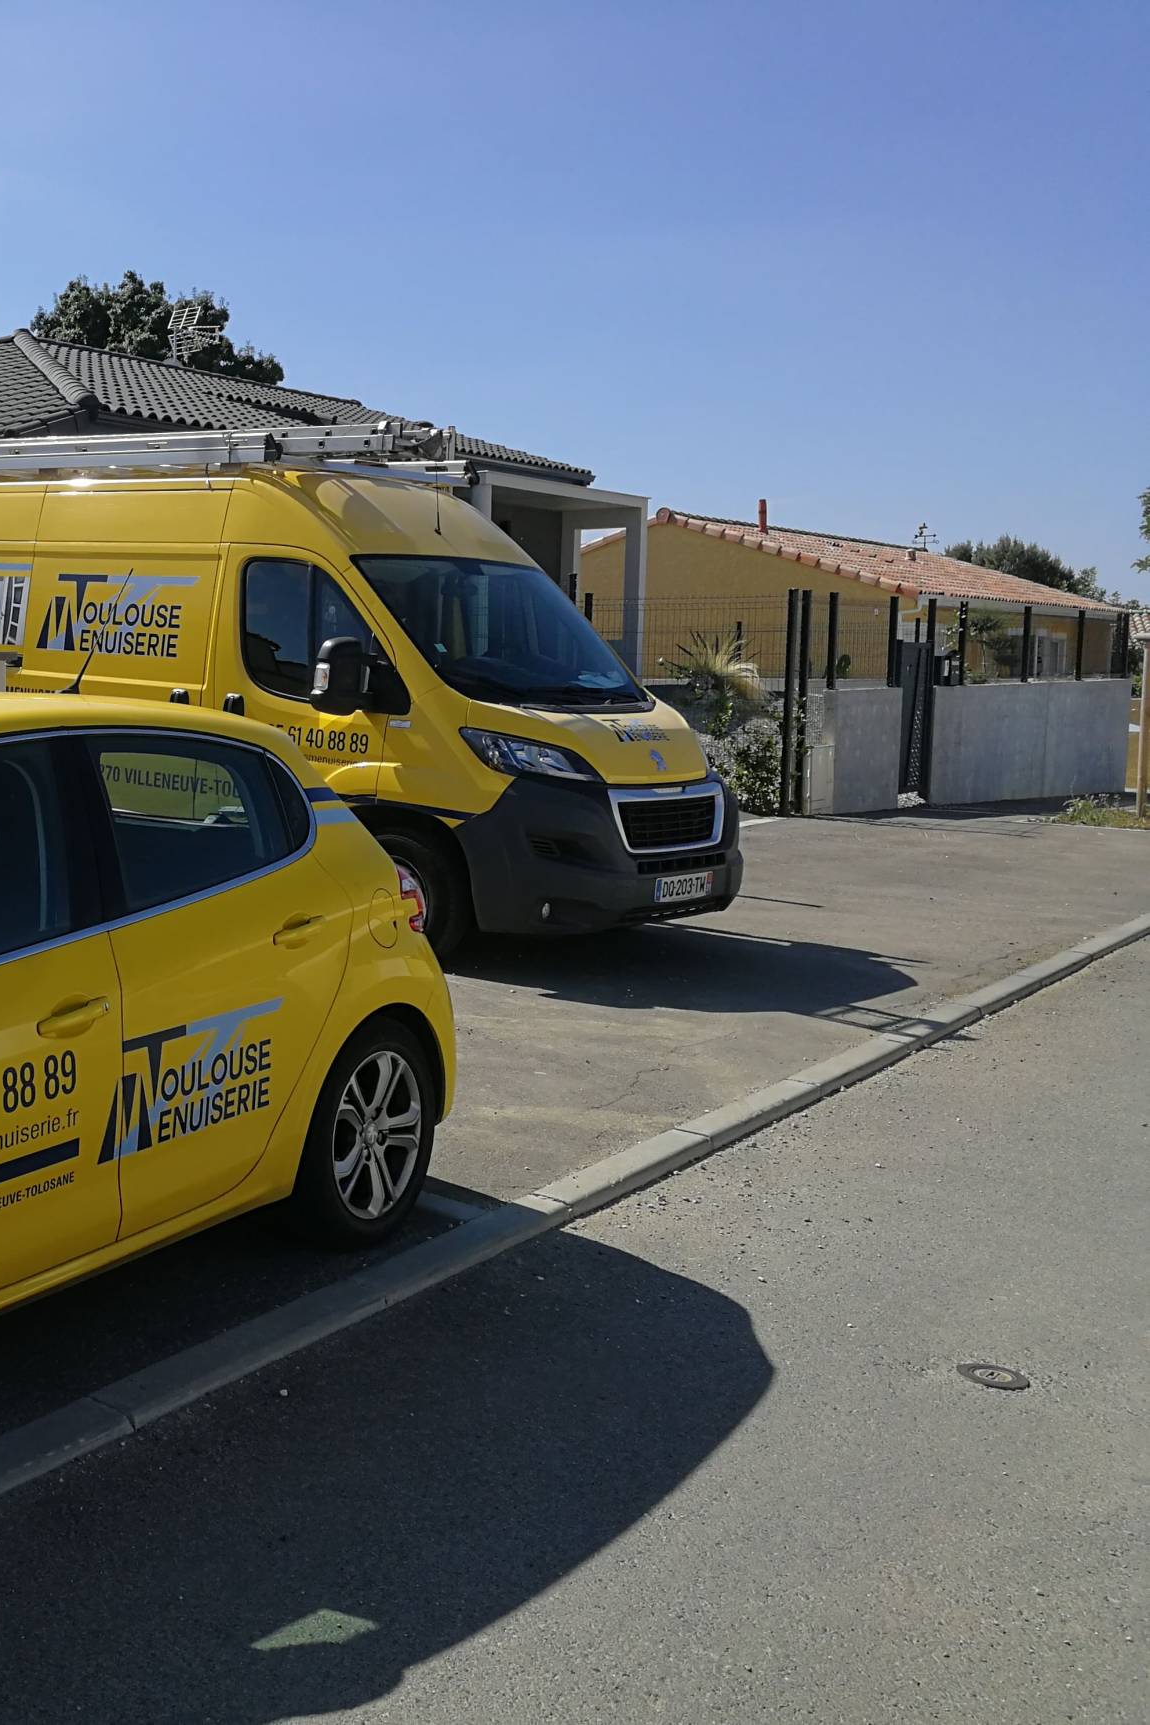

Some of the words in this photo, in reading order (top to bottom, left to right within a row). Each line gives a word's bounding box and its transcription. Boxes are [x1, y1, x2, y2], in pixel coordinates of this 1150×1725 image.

[36, 596, 179, 658] MENUISERIE
[58, 573, 182, 629] TOULOUSE
[306, 727, 324, 749] 40
[328, 730, 346, 752] 88
[350, 732, 369, 755] 89
[3, 1062, 36, 1113] 88
[44, 1050, 77, 1101] 89
[122, 1024, 272, 1106] TOULOUSE
[97, 1056, 271, 1165] MENUISERIE
